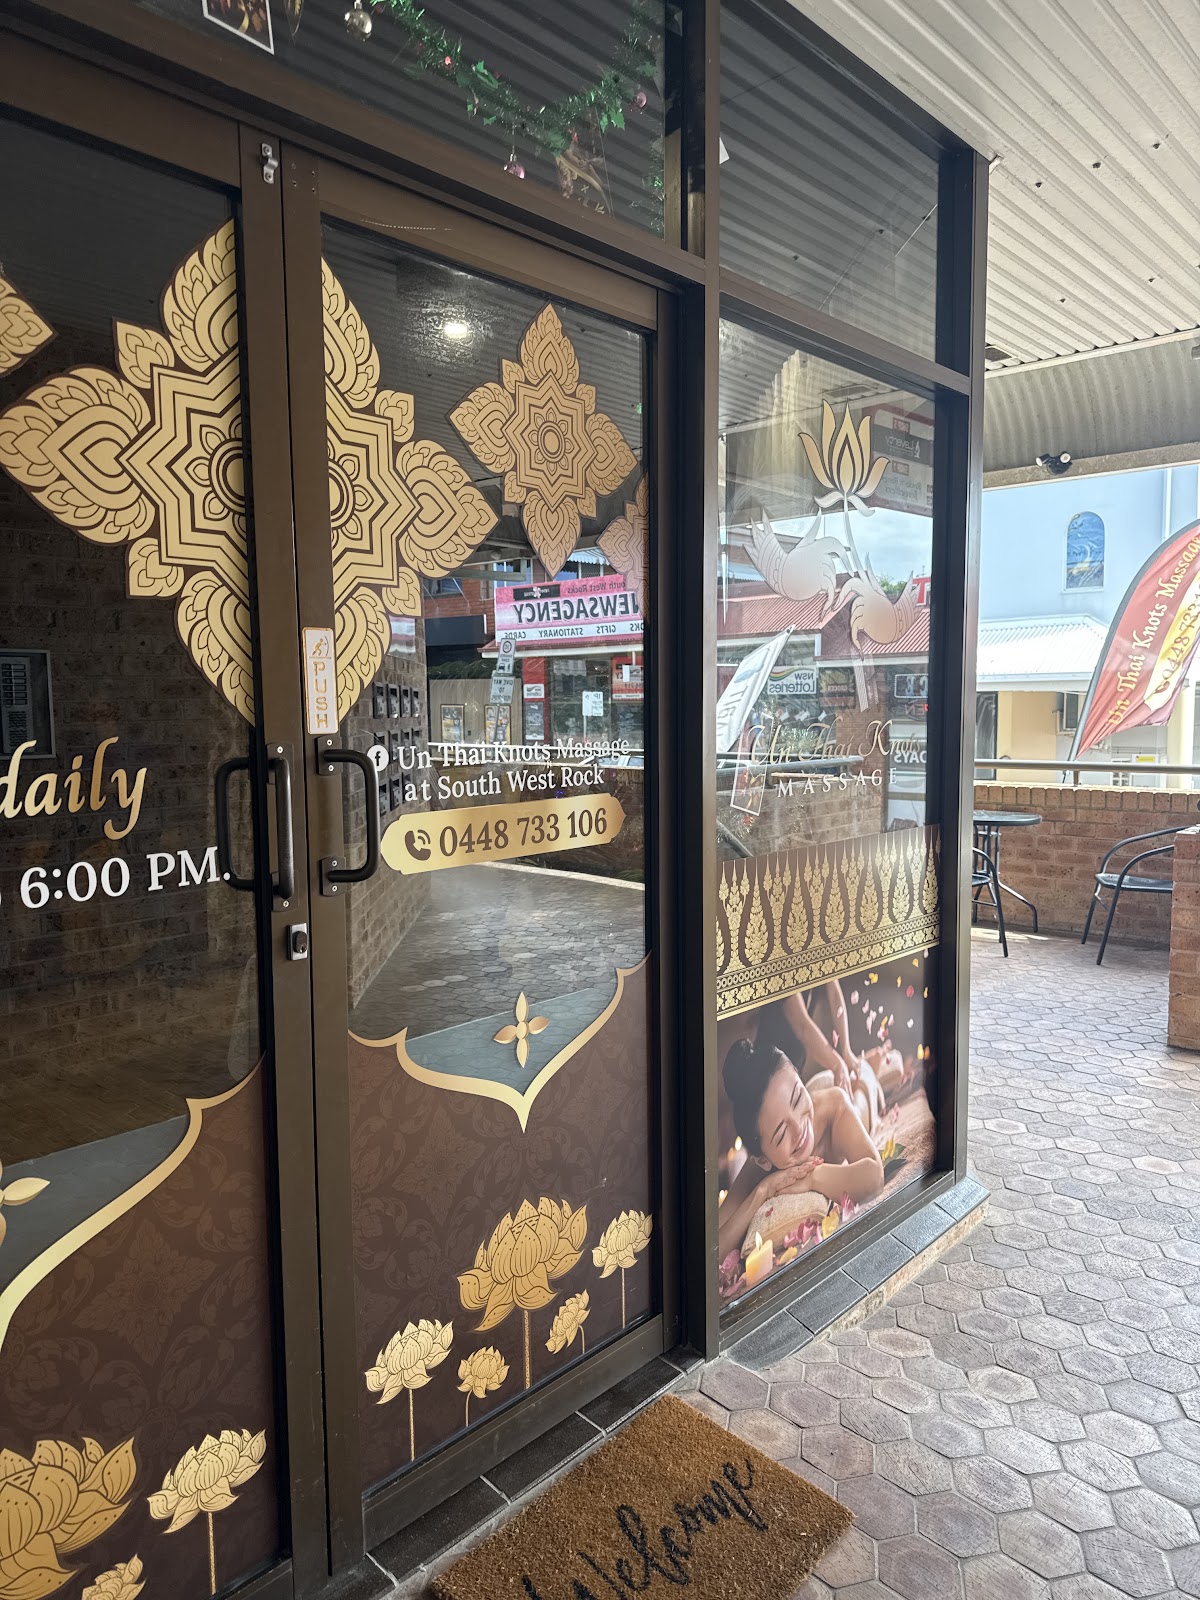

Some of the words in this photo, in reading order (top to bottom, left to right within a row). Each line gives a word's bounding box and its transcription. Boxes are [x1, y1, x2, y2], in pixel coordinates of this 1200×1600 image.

[1132, 602, 1168, 649] Knots
[312, 661, 329, 729] PUSH
[1117, 652, 1146, 694] Thai
[1106, 698, 1130, 726] Un
[397, 745, 432, 771] Un
[437, 741, 487, 768] Thai
[493, 741, 551, 764] Knots
[556, 737, 630, 762] Massage
[0, 736, 147, 840] daily
[405, 778, 431, 802] at
[438, 771, 501, 800] South
[507, 769, 556, 793] West
[561, 764, 605, 788] Rock
[777, 767, 897, 798] MASSAGE
[439, 818, 509, 857] 0448
[516, 812, 561, 846] 733
[568, 807, 608, 839] 106
[20, 856, 131, 909] 6:00
[146, 845, 231, 892] PM.
